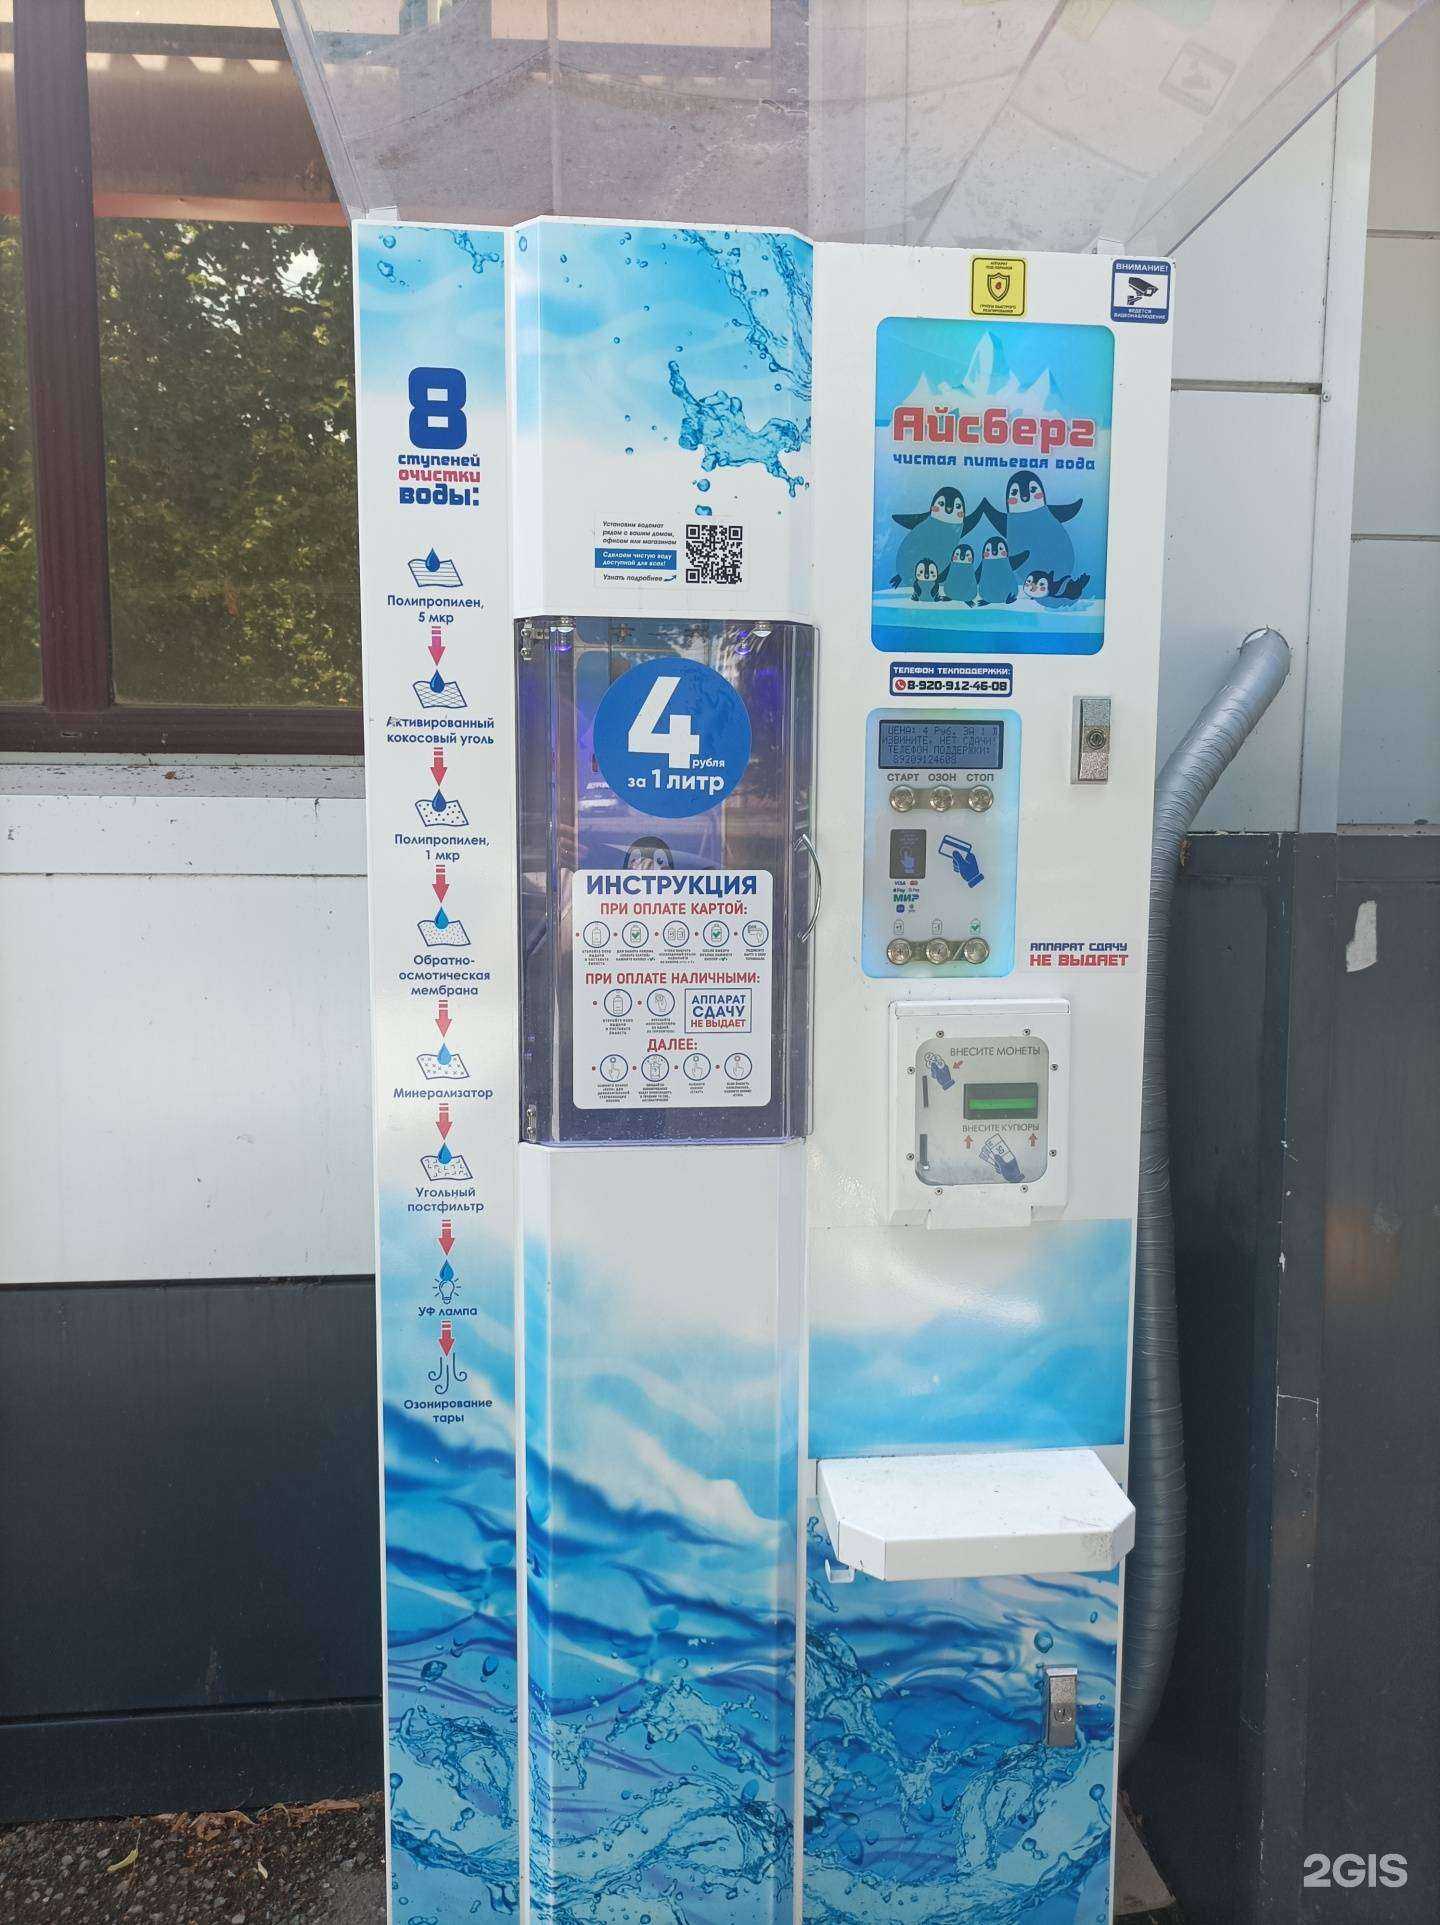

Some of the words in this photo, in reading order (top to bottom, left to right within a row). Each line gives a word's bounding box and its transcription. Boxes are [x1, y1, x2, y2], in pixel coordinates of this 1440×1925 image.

[1115, 263, 1169, 273] ВНИМАНИЕ!
[408, 367, 467, 450] 8
[893, 406, 1095, 454] Айсберг
[398, 454, 480, 470] ступеней
[893, 453, 957, 466] чистая
[964, 454, 1049, 469] питьевая
[1055, 457, 1095, 470] вода
[398, 469, 480, 483] очистки
[399, 484, 480, 507] воды:
[387, 595, 484, 610] Полипропилен,
[418, 612, 426, 623] 5
[428, 613, 454, 626] мкр
[893, 666, 935, 674] ТЕЛЕФОН
[907, 680, 1008, 691] 8-920-912-46-08
[628, 676, 700, 769] 4
[387, 731, 457, 745] кокосовый
[460, 735, 495, 747] уголь
[939, 735, 957, 745] НЕТ
[888, 745, 928, 754] ТЕЛЕФОН
[692, 757, 725, 769] рубля
[627, 776, 646, 788] за
[651, 769, 661, 788] 1
[666, 774, 725, 795] литр
[887, 773, 920, 782] СТАРТ
[928, 773, 957, 782] ОЗОН
[966, 773, 995, 782] СТОП
[394, 834, 490, 848] Полипропилен,
[425, 850, 431, 860] 1
[435, 851, 460, 864] мкр
[586, 875, 757, 898] ИНСТРУКЦИЯ
[893, 894, 920, 902] МИР
[600, 902, 628, 915] ПРИ
[633, 902, 686, 915] ОПЛАТЕ
[691, 900, 748, 915] КАРТОЙ:
[1030, 942, 1085, 951] АППАРАТ
[1089, 942, 1128, 951] СДАЧУ
[413, 954, 475, 968] Обратно-
[1029, 954, 1052, 967] НЕ
[1058, 954, 1129, 967] ВЫДАЕТ
[398, 971, 491, 982] осмотическая
[585, 973, 612, 984] ПРИ
[616, 973, 667, 984] ОПЛАТЕ
[671, 972, 760, 984] НАЛИЧНЫМИ:
[410, 984, 479, 998] мембрана
[691, 994, 746, 1005] АППАРАТ
[692, 1005, 745, 1019] СДАЧУ
[690, 1019, 703, 1028] НЕ
[705, 1019, 746, 1029] ВЫДАЕТ
[647, 1038, 698, 1052] ДАЛЕЕ:
[950, 1047, 994, 1057] ВНЕСИТЕ
[996, 1046, 1041, 1056] МОНЕТЫ
[393, 1088, 493, 1100] Минерализатор
[962, 1124, 1000, 1133] ВНЕСИТЕ
[1001, 1123, 1040, 1132] КУПЮРЫ
[415, 1187, 476, 1200] Угольный
[407, 1200, 484, 1214] постфильтр
[418, 1305, 435, 1318] УФ
[438, 1307, 478, 1317] лампа
[404, 1399, 493, 1411] Озонирование
[432, 1415, 464, 1426] тары
